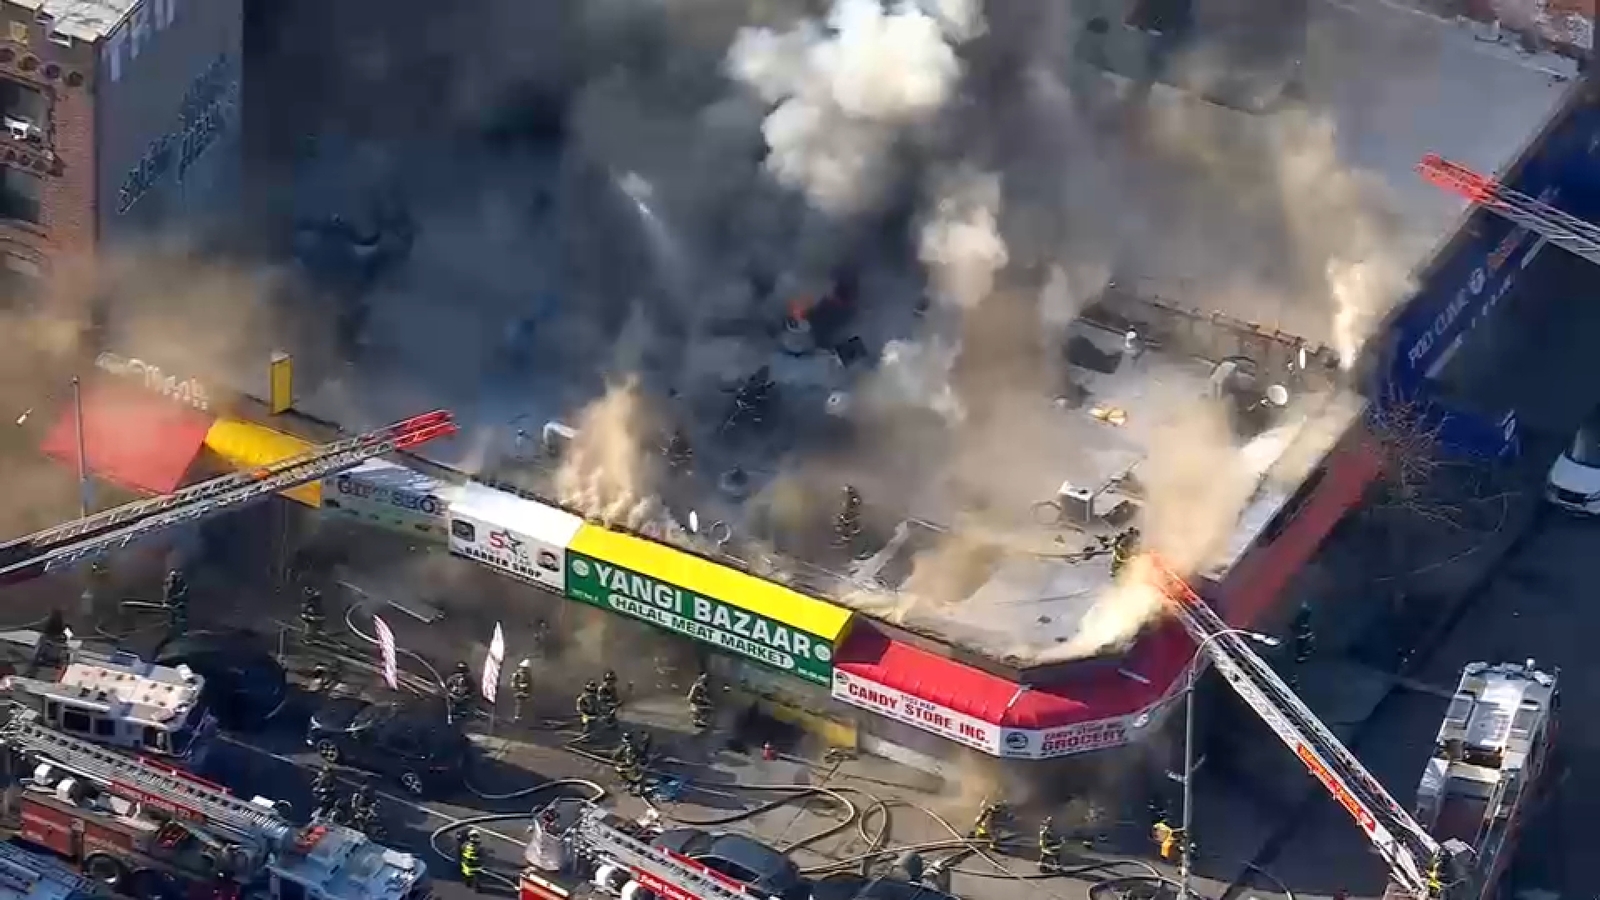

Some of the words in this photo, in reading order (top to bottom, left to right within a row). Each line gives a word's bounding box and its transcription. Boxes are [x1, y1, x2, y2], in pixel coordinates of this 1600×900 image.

[512, 562, 542, 578] SHOP
[593, 562, 682, 613] YANGI
[694, 596, 811, 658] BAZAAR
[614, 594, 667, 624] HALAL
[671, 616, 714, 640] MEAT
[720, 631, 787, 667] MARKET
[848, 682, 898, 709] CANDY
[904, 702, 954, 731] STORE
[959, 722, 991, 744] INC.
[1041, 728, 1127, 752] GROCERY
